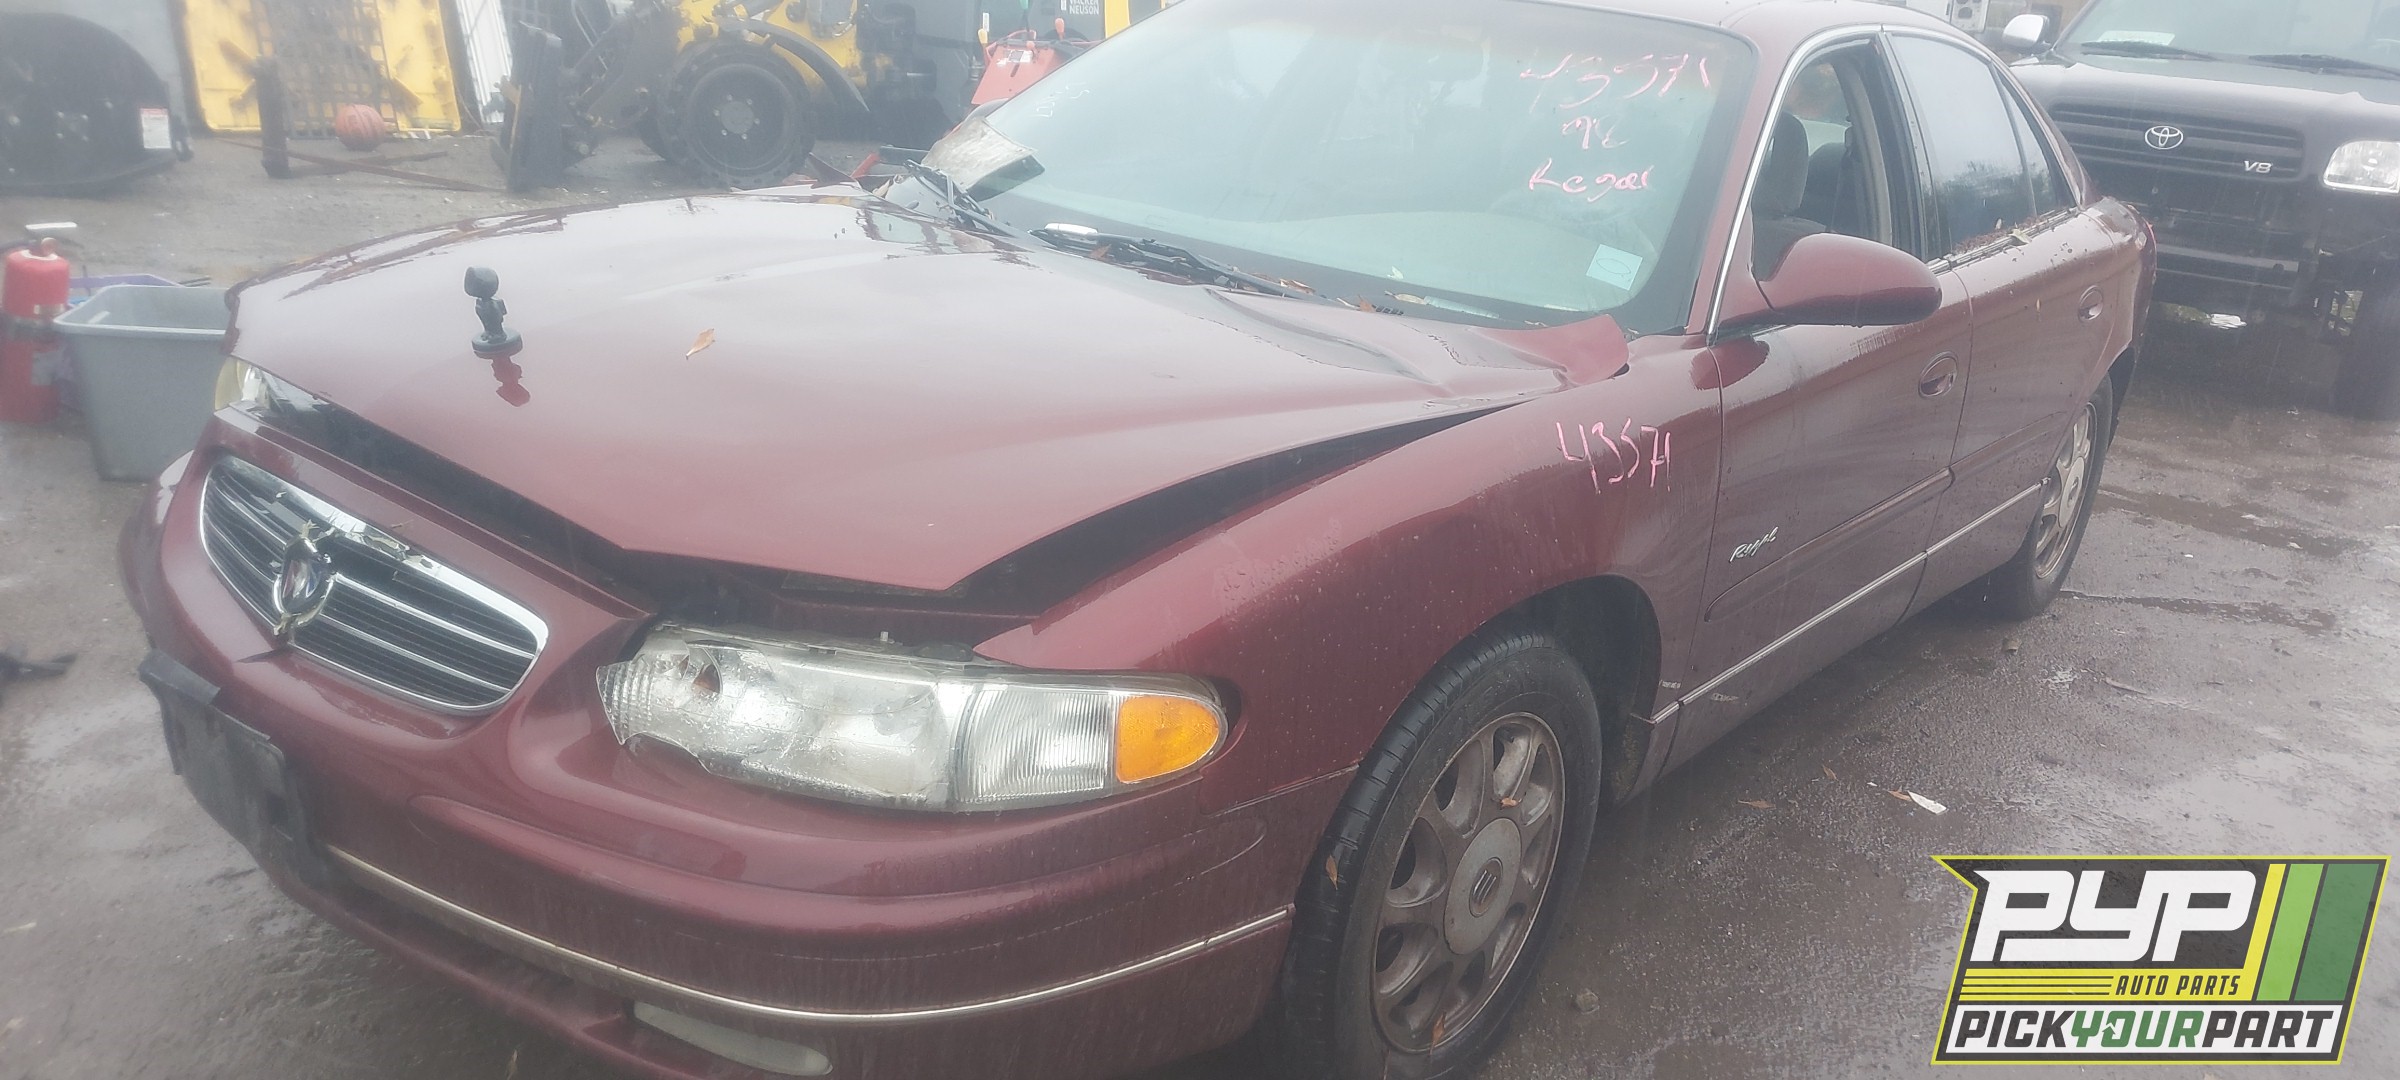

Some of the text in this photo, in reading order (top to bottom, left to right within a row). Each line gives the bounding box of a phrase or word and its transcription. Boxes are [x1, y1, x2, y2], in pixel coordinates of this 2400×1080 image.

[1069, 5, 1099, 15] NEUSON
[2244, 160, 2272, 173] V8
[1556, 418, 1671, 494] 43571
